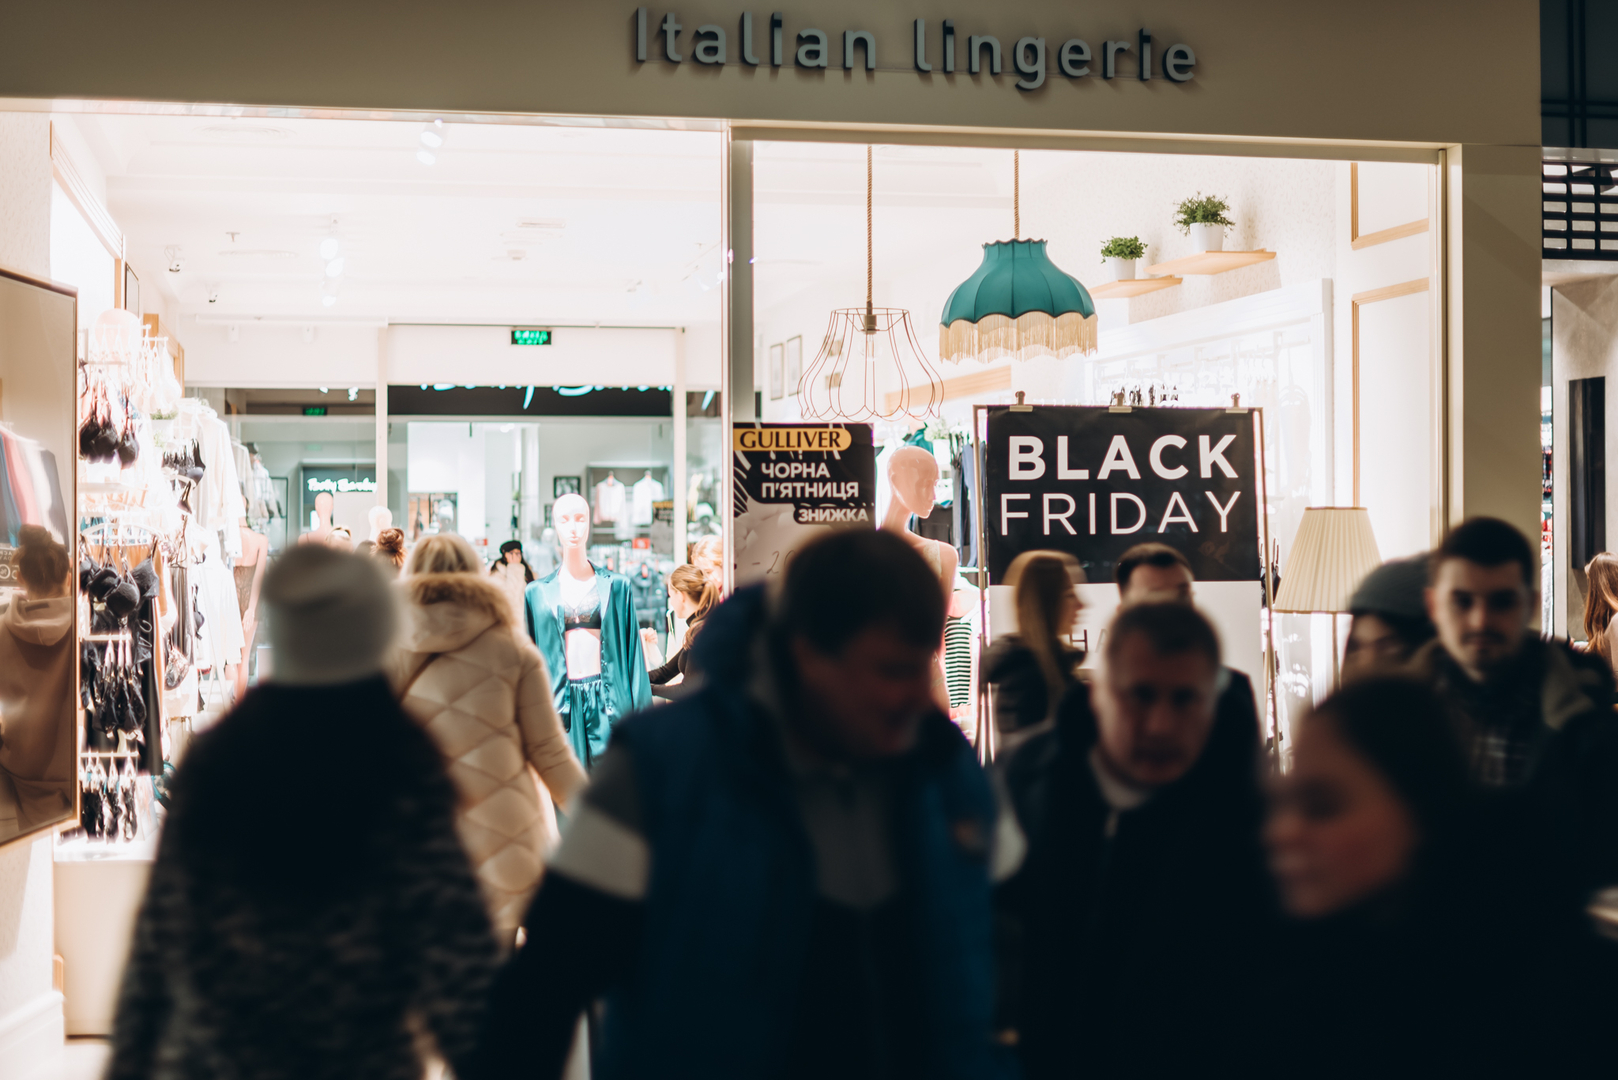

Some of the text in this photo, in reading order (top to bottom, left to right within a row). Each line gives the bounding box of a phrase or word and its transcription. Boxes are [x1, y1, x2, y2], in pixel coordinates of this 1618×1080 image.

[635, 7, 1197, 90] Italian lingerie
[739, 430, 842, 449] GULLIVER
[1008, 434, 1239, 480] BLACK
[760, 462, 831, 479] ЧОРНА
[761, 481, 859, 500] П'ЯТНИЦЯ
[798, 508, 869, 522] ЗНИЖКА
[1001, 491, 1241, 536] FRIDAY
